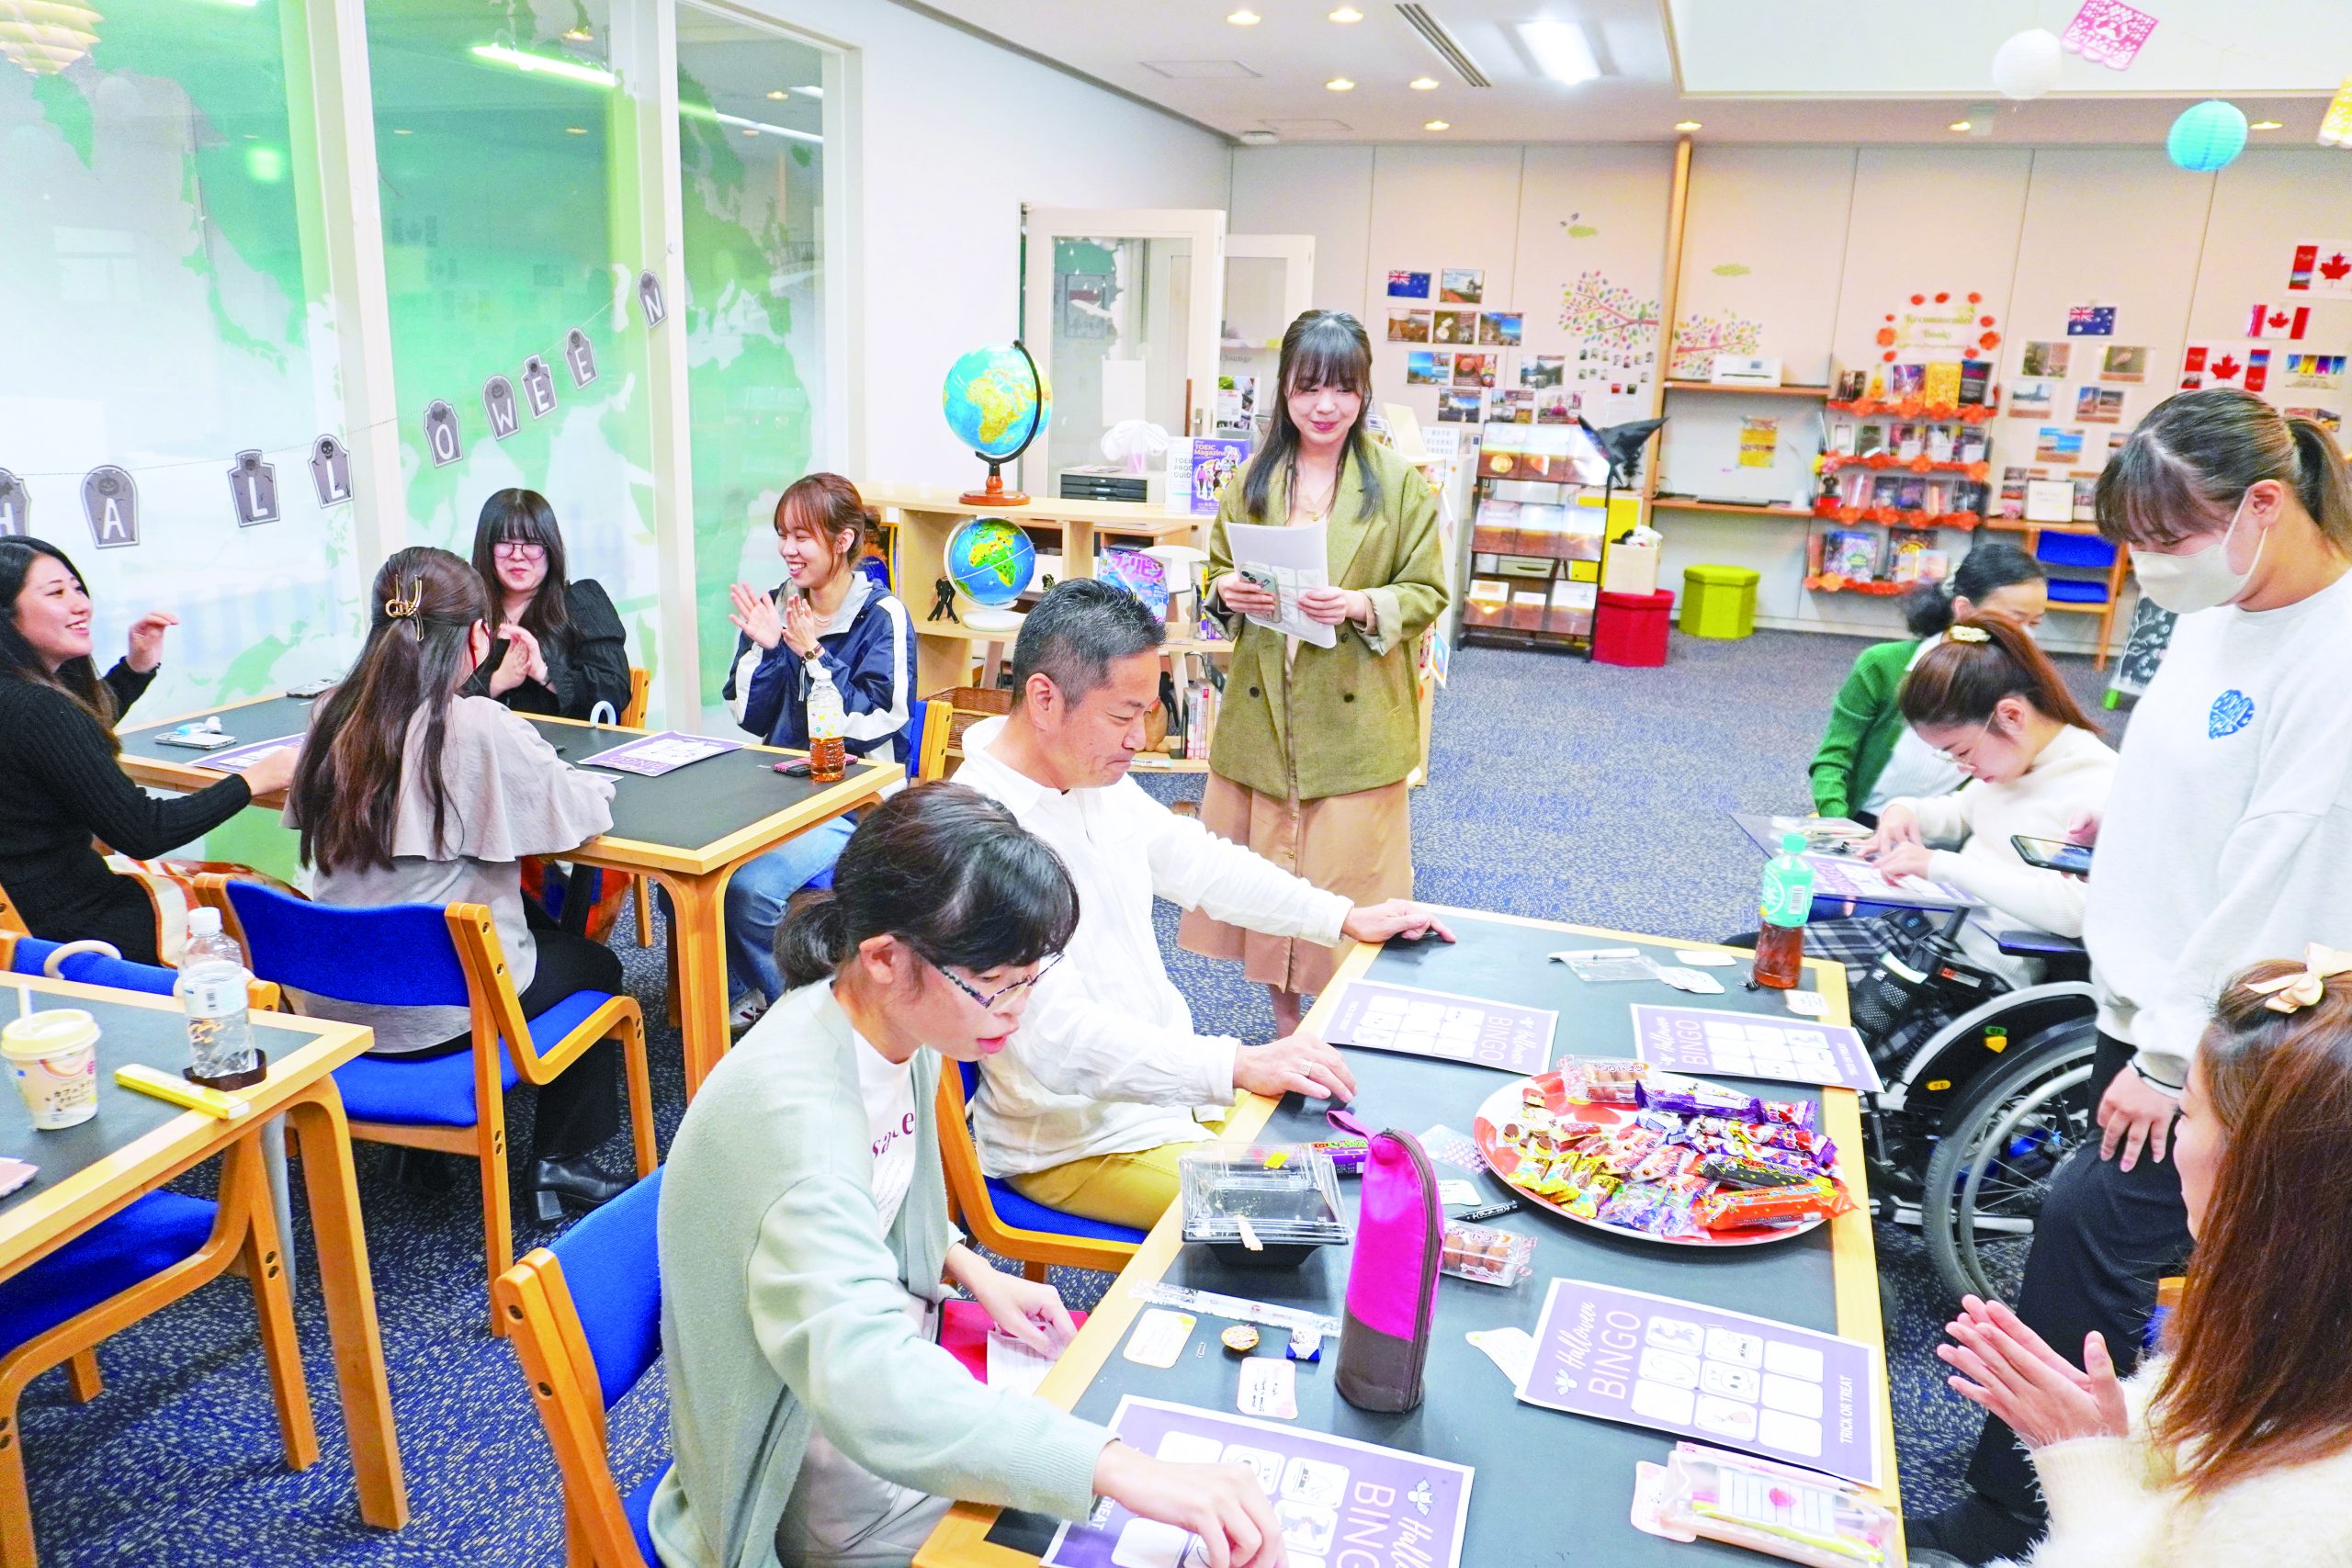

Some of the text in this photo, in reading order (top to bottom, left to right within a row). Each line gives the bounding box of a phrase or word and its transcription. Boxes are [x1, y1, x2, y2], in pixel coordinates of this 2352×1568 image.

[1110, 554, 1164, 579] フィリピン
[1478, 1016, 1514, 1061] BINGO
[1675, 1020, 1709, 1066] BINGO
[1555, 1301, 1597, 1370] Halloween
[1588, 1310, 1642, 1400] BINGO
[1839, 1373, 1853, 1444] TRICK OR TREAT
[1336, 1481, 1396, 1568] BING
[1389, 1517, 1434, 1568] Hall
